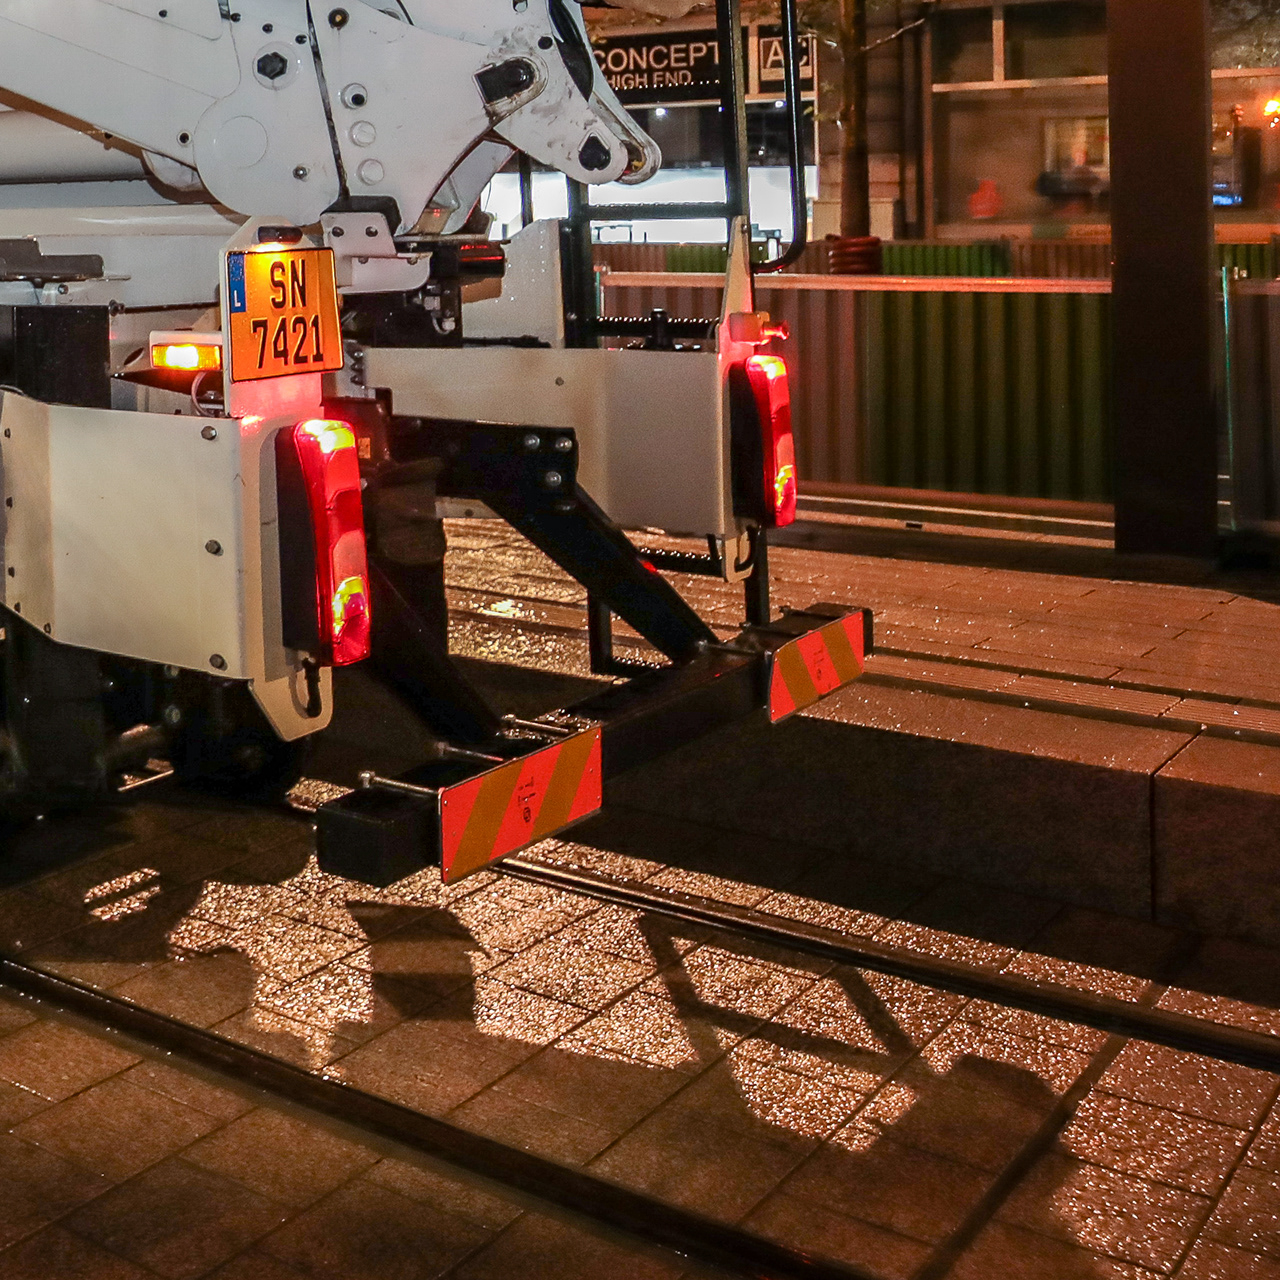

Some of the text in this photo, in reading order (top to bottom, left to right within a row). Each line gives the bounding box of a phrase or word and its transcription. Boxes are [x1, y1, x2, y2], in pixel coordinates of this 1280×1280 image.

[605, 70, 692, 88] HIGH END
[233, 289, 241, 307] L
[270, 259, 307, 309] SN
[251, 315, 324, 369] 7421
